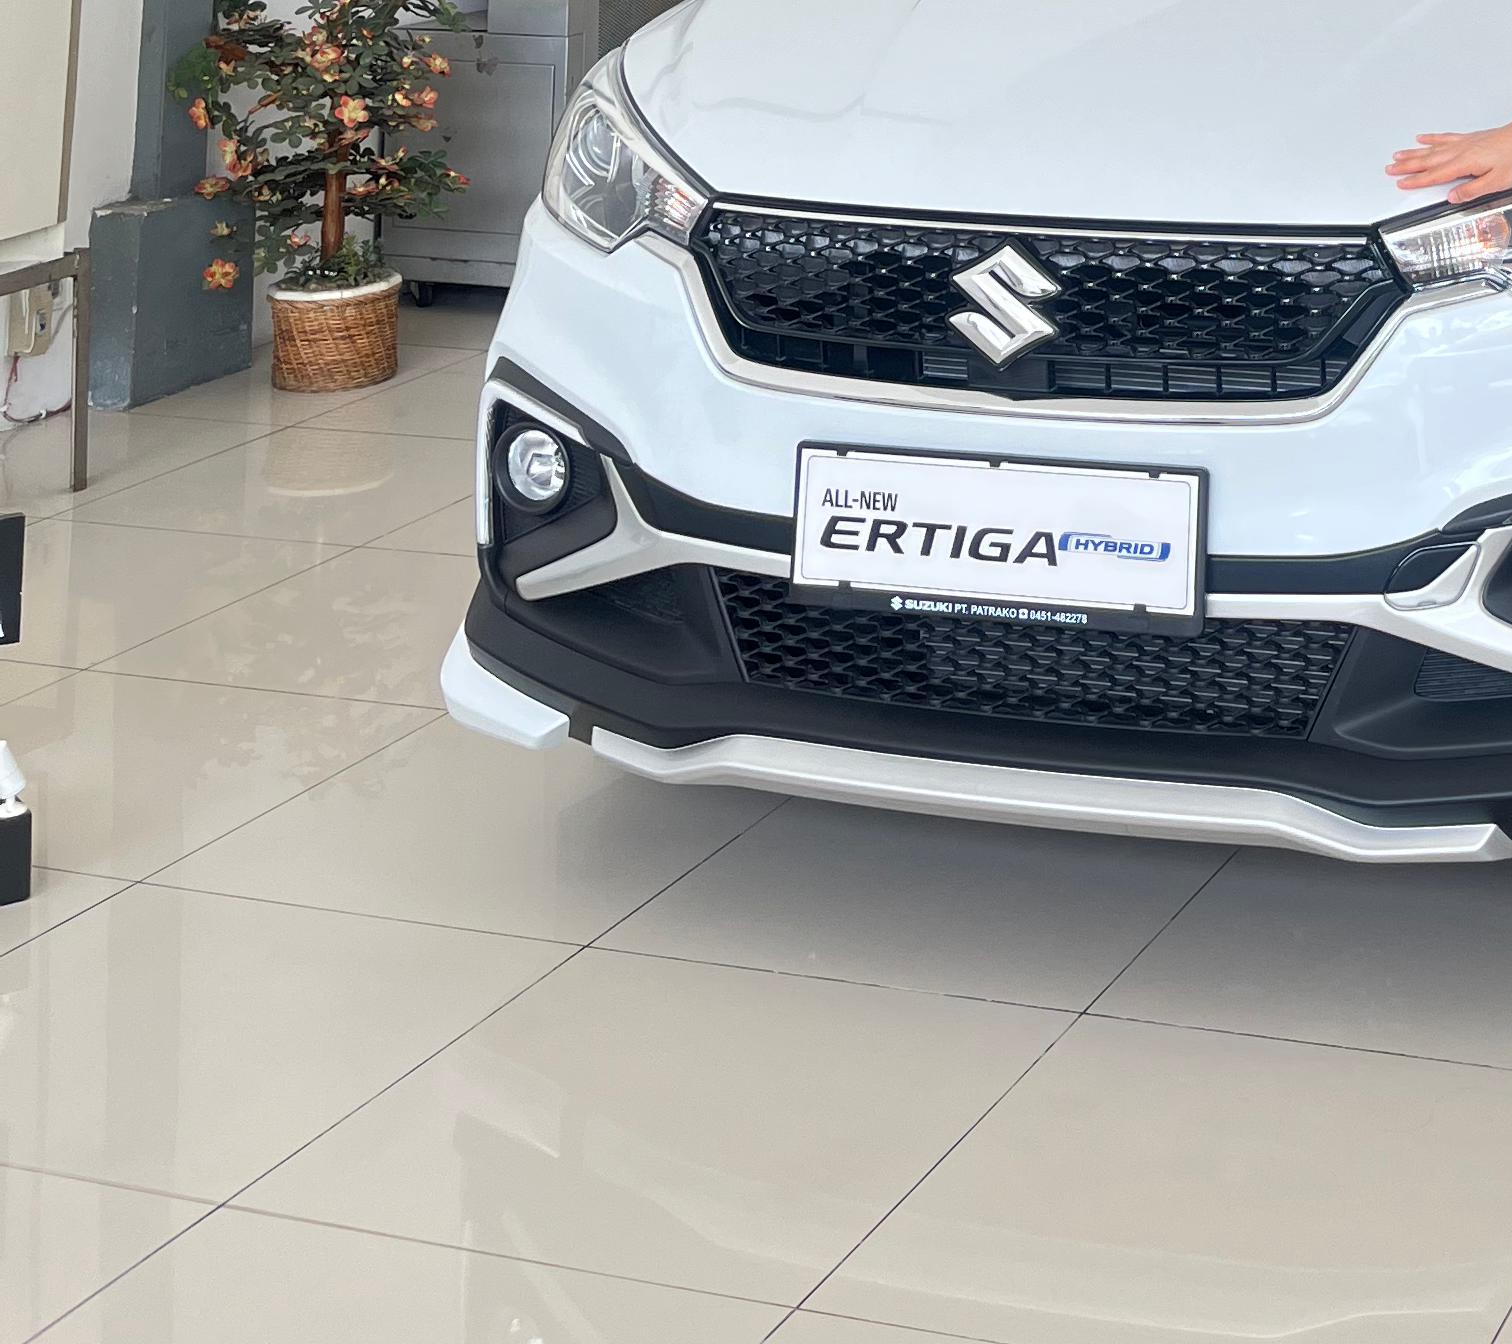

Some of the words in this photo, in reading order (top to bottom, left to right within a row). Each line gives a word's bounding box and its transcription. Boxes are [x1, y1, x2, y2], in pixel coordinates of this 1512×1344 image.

[822, 488, 898, 512] ALL-NEW
[819, 515, 1058, 567] ERTIGA
[1074, 538, 1155, 555] HYBRID
[904, 599, 953, 613] SUZUKI
[954, 603, 969, 614] PT.
[970, 604, 1017, 619] PATRAKO
